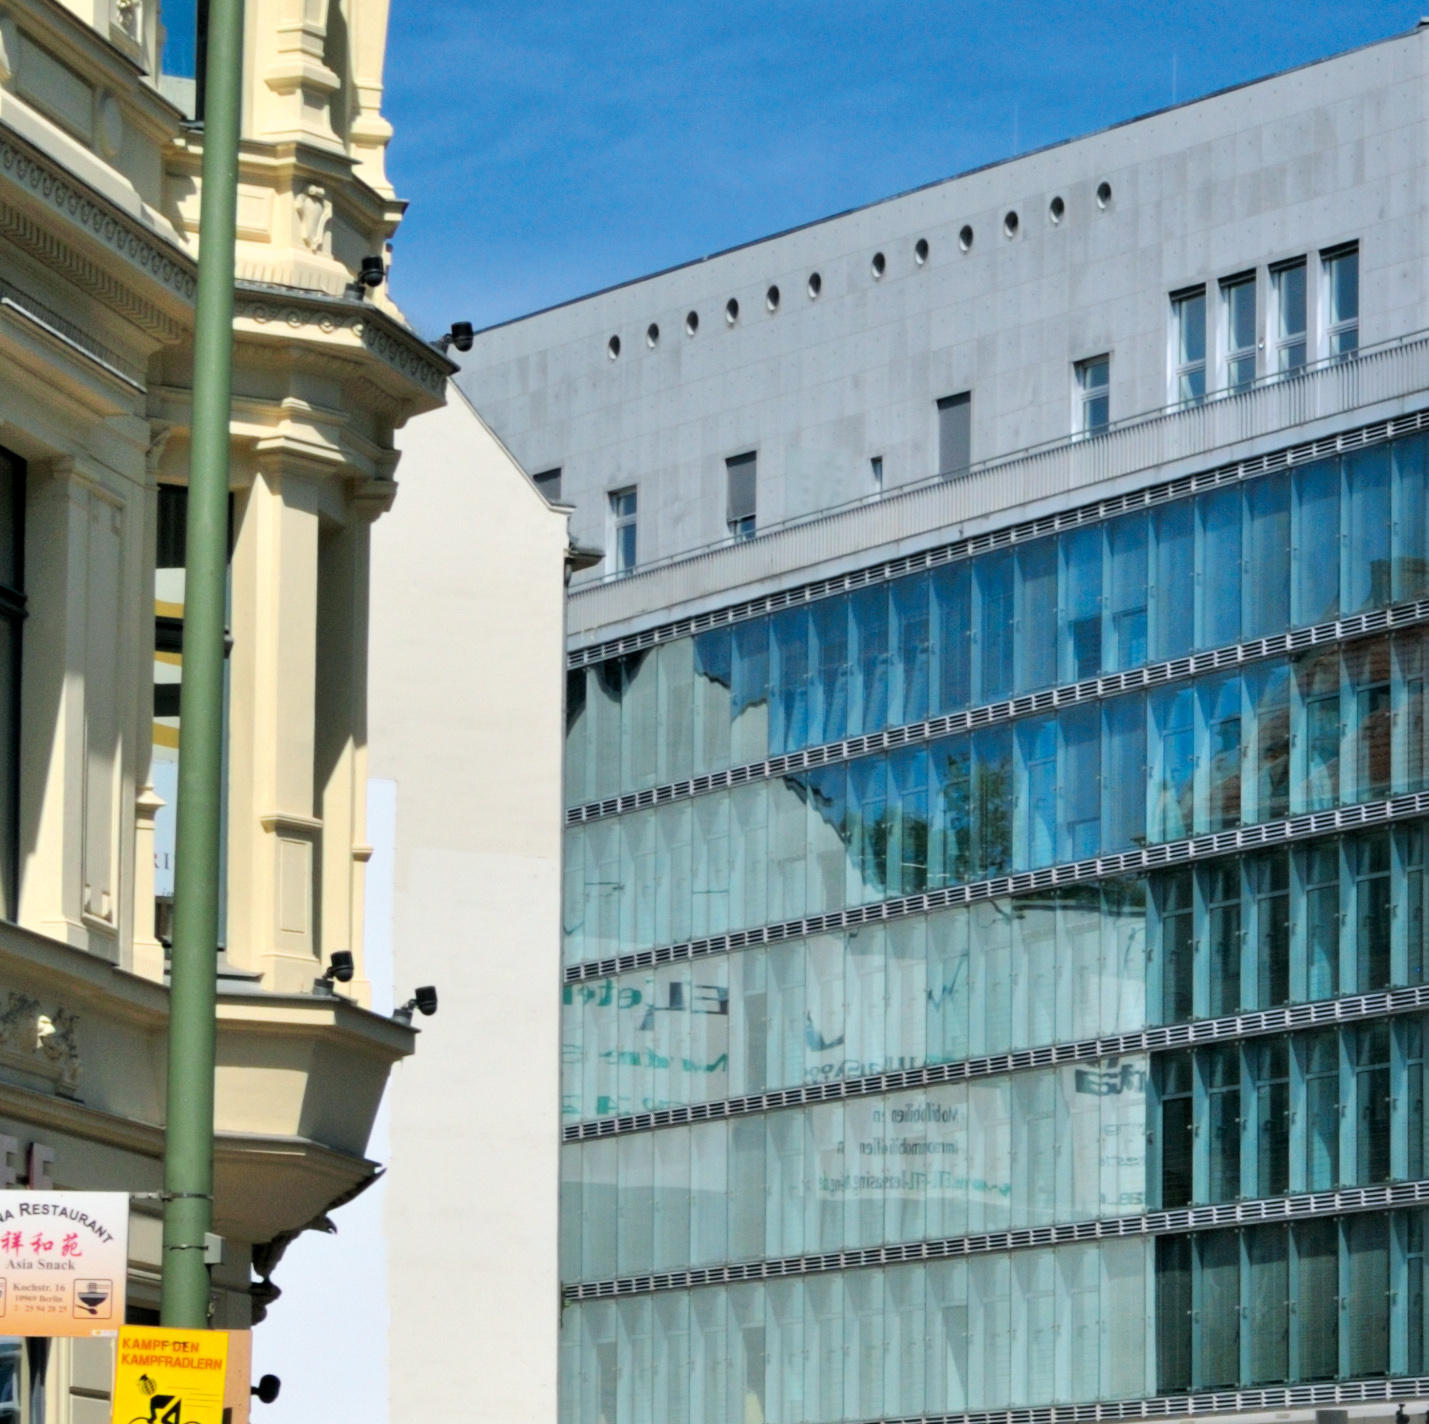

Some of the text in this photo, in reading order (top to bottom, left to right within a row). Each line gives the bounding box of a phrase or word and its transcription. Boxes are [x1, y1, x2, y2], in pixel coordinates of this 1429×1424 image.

[19, 1203, 114, 1243] RESTAURANT
[6, 1260, 75, 1271] Asia Snack
[13, 1283, 65, 1292] Kochstr. 16
[122, 1338, 199, 1353] KAMPF DEN
[121, 1353, 223, 1371] KAMPFRADLERN
